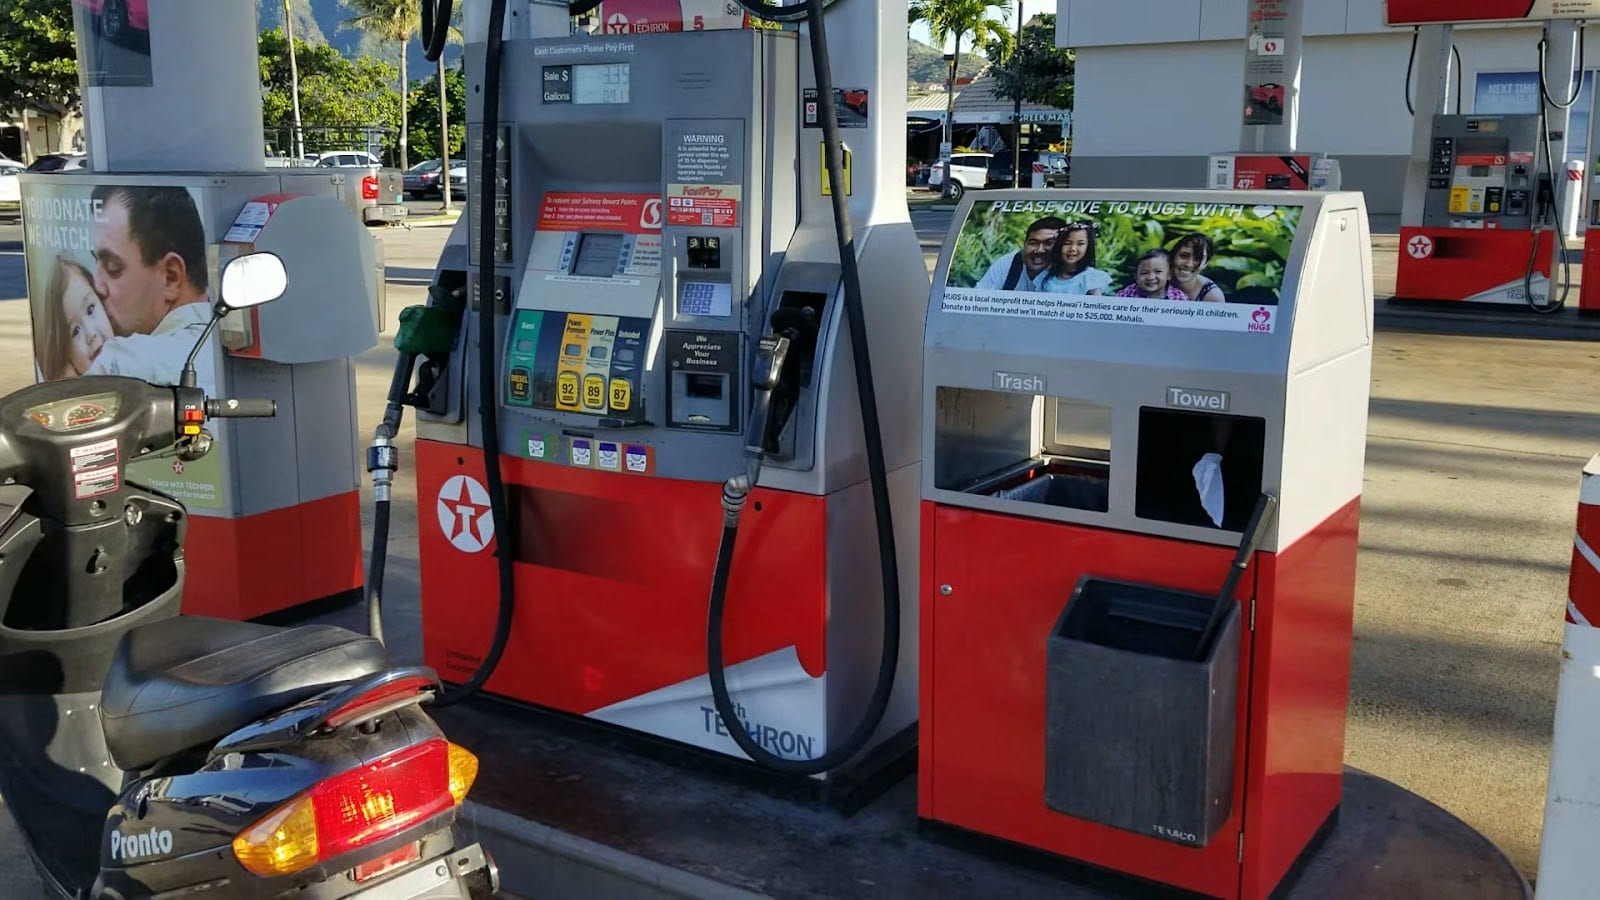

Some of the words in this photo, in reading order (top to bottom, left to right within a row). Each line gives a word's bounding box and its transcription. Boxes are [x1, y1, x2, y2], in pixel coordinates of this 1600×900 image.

[632, 23, 669, 33] TECHRON
[550, 46, 582, 54] Customers
[583, 44, 604, 53] Please
[605, 43, 617, 53] Pay
[619, 43, 634, 52] First
[544, 72, 560, 81] Sale
[544, 92, 570, 101] Gallons
[683, 134, 724, 143] WARNING
[682, 186, 722, 198] FastPay
[992, 201, 1055, 213] PLEASE
[1062, 202, 1102, 214] GIVE
[1108, 202, 1130, 214] TO
[1135, 202, 1187, 216] HUGS
[1194, 204, 1245, 217] WITH
[941, 303, 964, 311] Donate
[1007, 307, 1019, 315] and
[1037, 309, 1058, 317] match
[1085, 312, 1114, 321] $25,000.
[1116, 314, 1144, 323] Mahalo.
[992, 296, 1021, 304] nonprofit
[1083, 302, 1111, 310] families
[1161, 308, 1196, 316] seriously
[1205, 309, 1240, 319] children.
[1248, 323, 1271, 331] HUGS
[682, 342, 721, 350] Appreciate
[694, 350, 710, 358] Your
[686, 357, 718, 366] Business
[997, 373, 1043, 391] Trash
[562, 383, 574, 395] 92
[588, 386, 600, 398] 89
[614, 389, 626, 401] 87
[1170, 388, 1225, 409] Towel
[700, 706, 812, 759] TEHRON
[111, 826, 173, 859] Pronto
